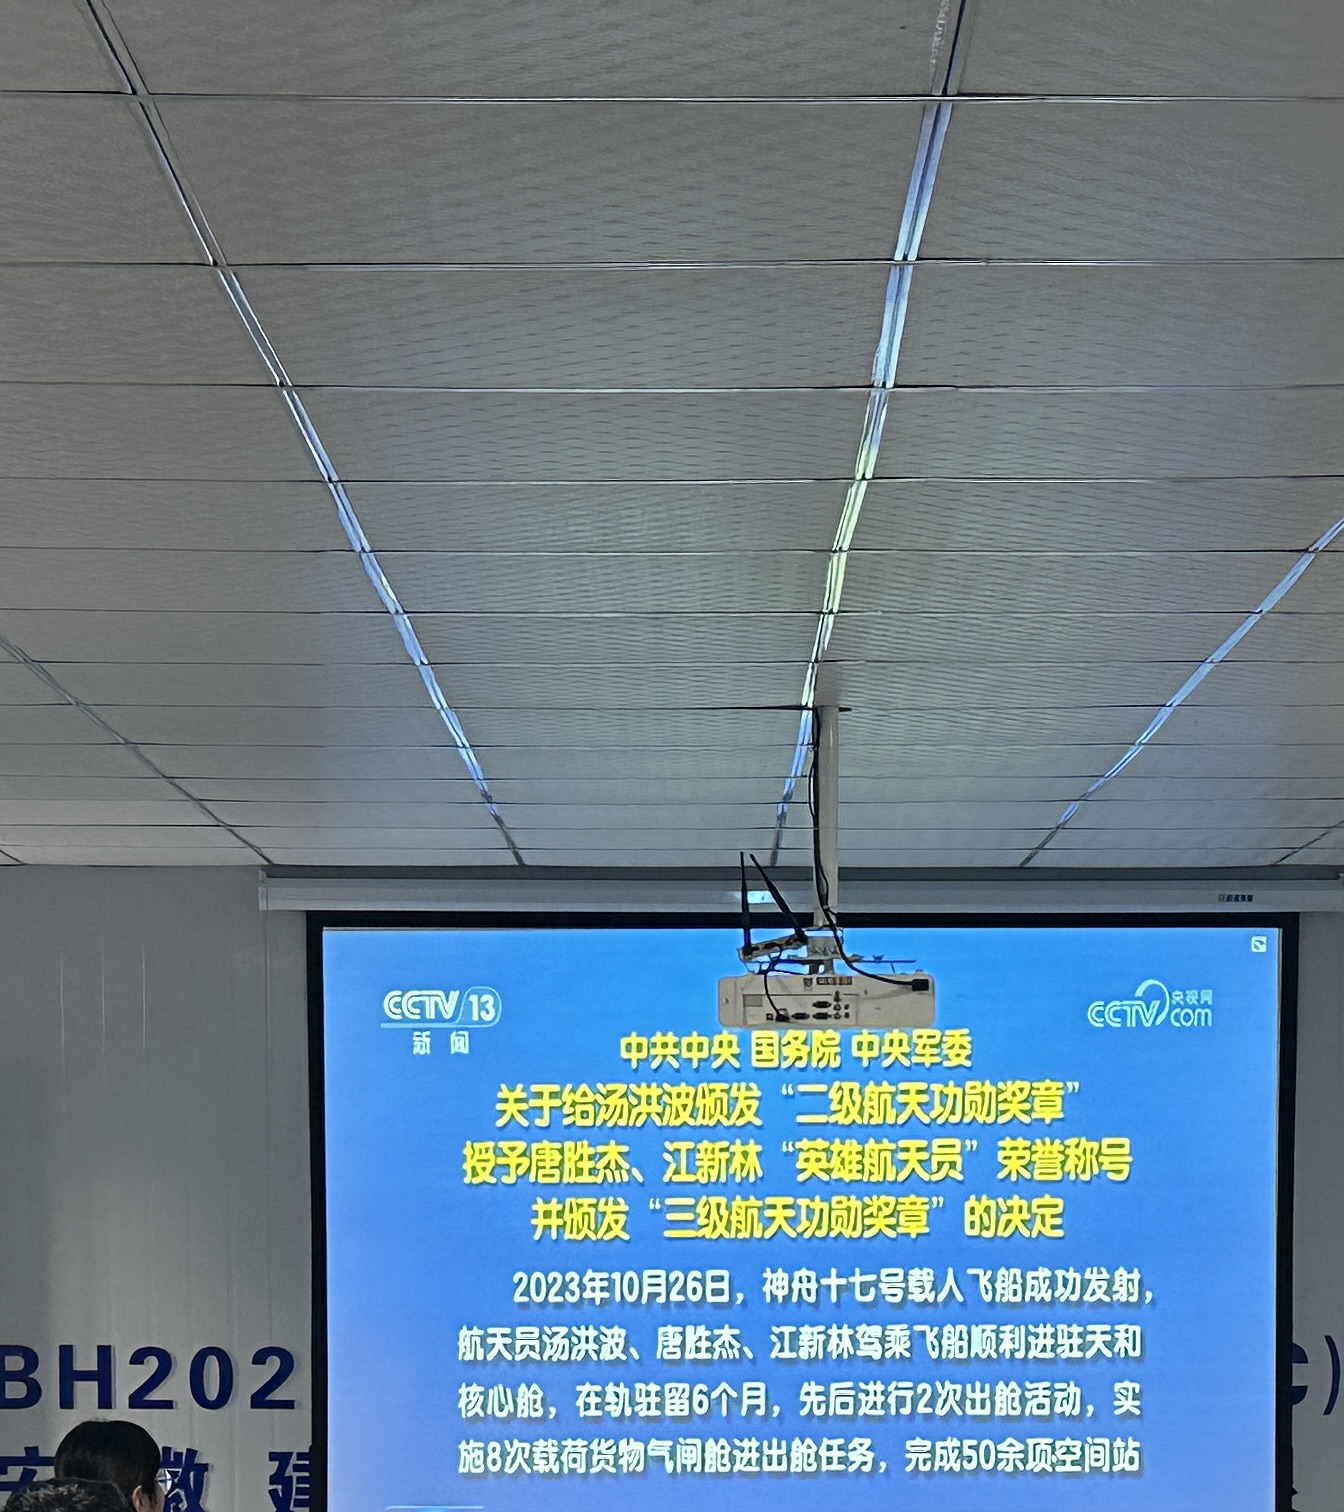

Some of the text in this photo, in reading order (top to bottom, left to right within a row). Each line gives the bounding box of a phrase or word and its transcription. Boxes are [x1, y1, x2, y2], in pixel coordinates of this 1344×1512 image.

[383, 990, 496, 1021] CCTV 13
[1087, 998, 1213, 1028] CCTV com
[619, 1028, 973, 1069] 中共中央 国务院 中央军委
[458, 1323, 1142, 1362] 航天员汤洪波、唐胜杰、江新林驾乘飞船顺利进驻天和
